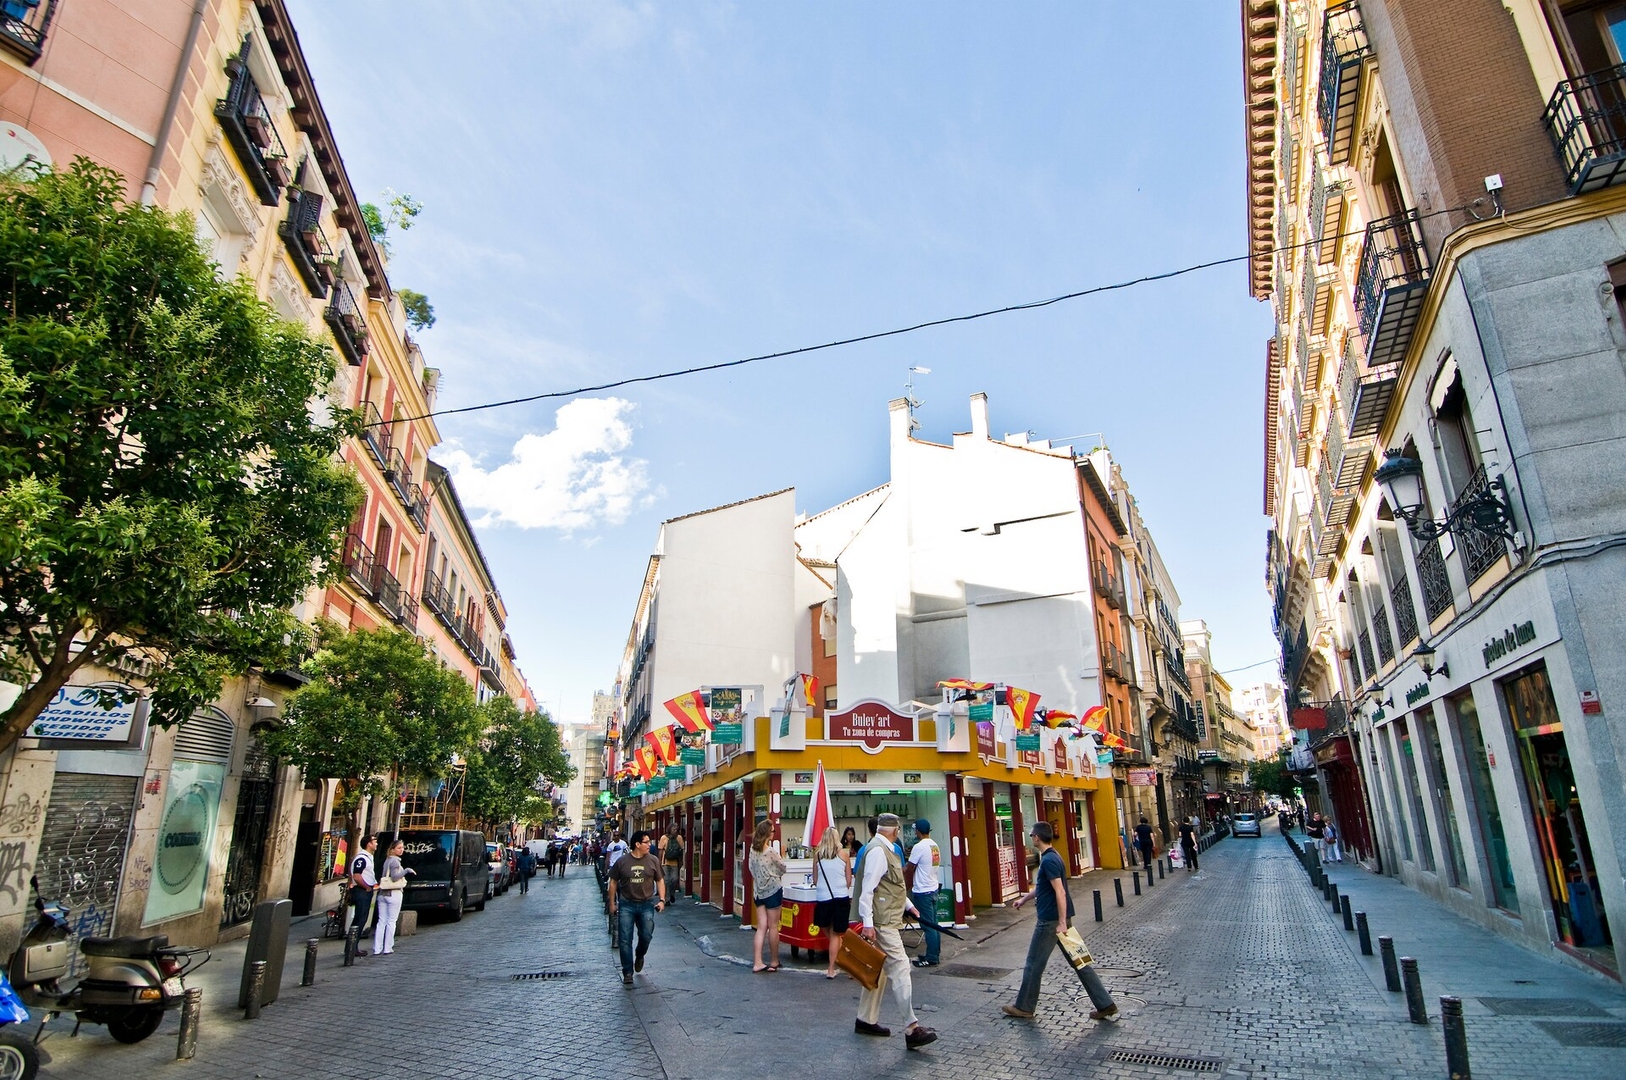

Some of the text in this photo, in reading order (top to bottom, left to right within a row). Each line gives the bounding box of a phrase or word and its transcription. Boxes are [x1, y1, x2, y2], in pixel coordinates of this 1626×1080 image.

[1504, 629, 1517, 652] de
[42, 707, 131, 718] OCADILLOS
[37, 715, 128, 725] ANDWICHS
[843, 726, 900, 739] Tu zona de compras
